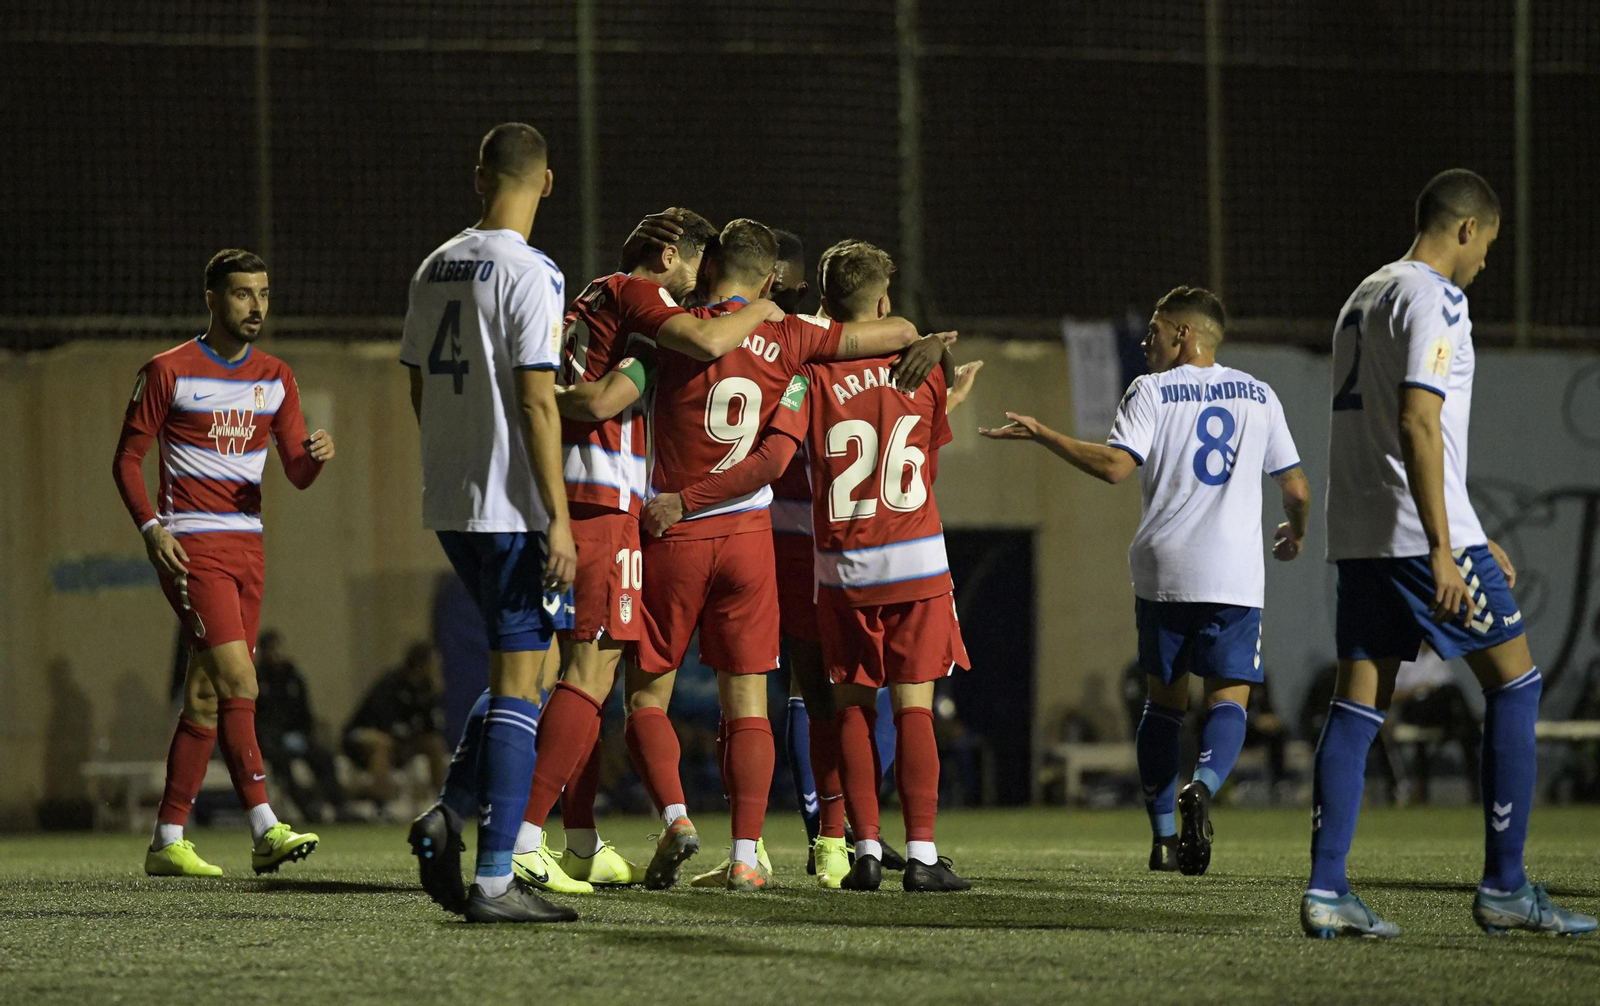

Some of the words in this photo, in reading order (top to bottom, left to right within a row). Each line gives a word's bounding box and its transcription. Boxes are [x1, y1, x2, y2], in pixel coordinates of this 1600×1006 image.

[427, 259, 494, 284] ALBERTO
[428, 299, 469, 395] 4
[737, 334, 781, 363] ADO
[1333, 309, 1363, 411] 2
[832, 366, 916, 405] ARAN
[1160, 384, 1201, 404] JUAN
[1203, 381, 1267, 404] ANDRÉS
[215, 425, 250, 438] WINAMAX
[704, 376, 763, 474] 9
[1192, 406, 1236, 486] 8
[825, 415, 927, 522] 26
[616, 548, 643, 591] 10
